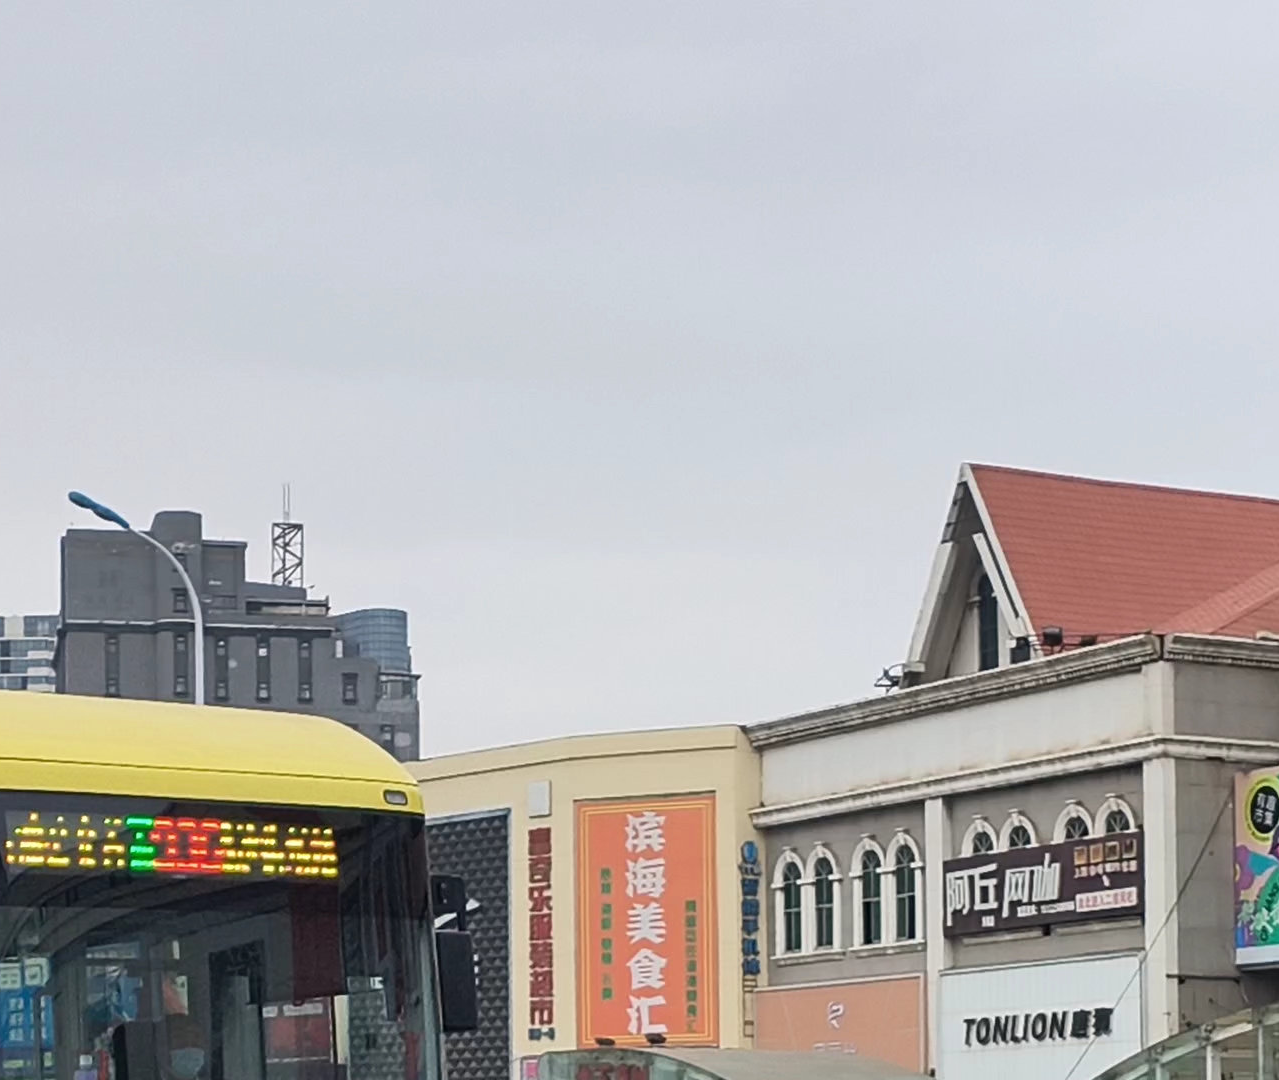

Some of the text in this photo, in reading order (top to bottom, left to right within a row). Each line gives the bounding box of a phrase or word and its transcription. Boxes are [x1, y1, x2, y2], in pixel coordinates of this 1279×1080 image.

[625, 811, 668, 1036] 滨海美食汇
[963, 1011, 1068, 1046] TONLION
